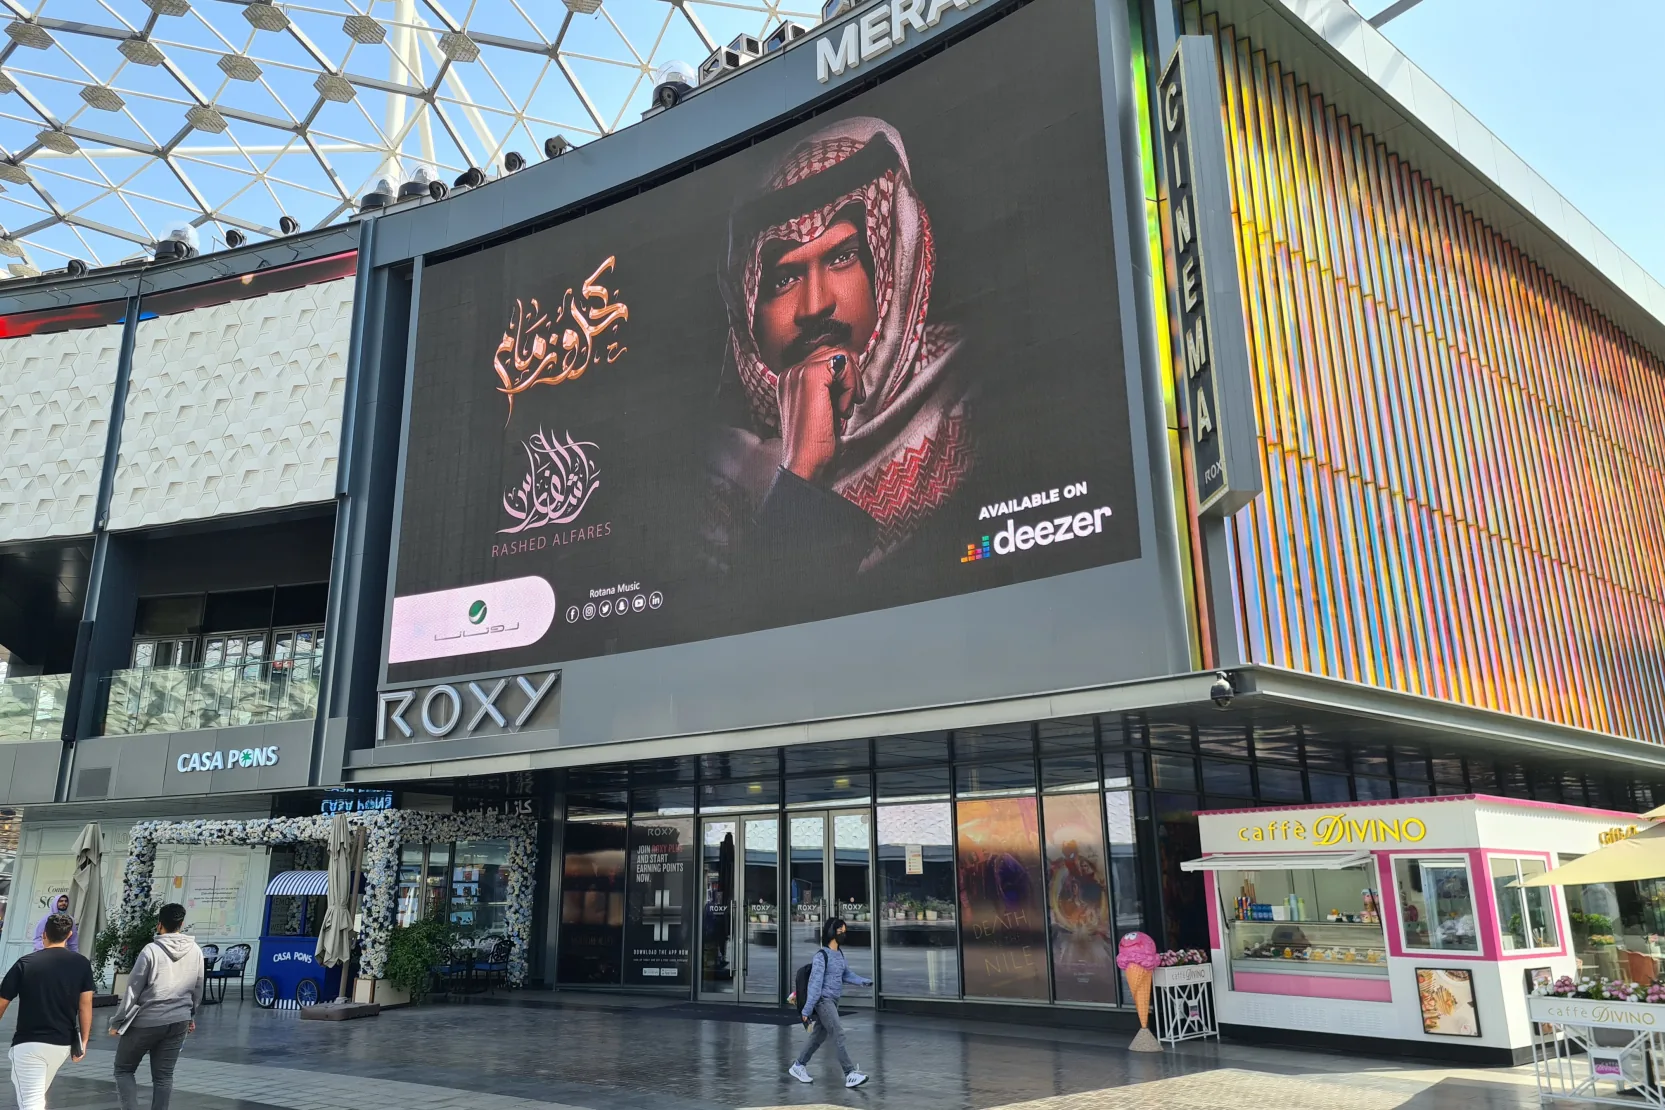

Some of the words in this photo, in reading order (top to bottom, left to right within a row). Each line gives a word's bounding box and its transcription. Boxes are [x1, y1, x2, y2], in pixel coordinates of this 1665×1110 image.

[816, 0, 980, 84] MER
[1165, 82, 1212, 442] CINEMA
[978, 488, 1060, 520] AVAILABLE
[1063, 481, 1088, 499] ON
[491, 536, 547, 557] RASHED
[552, 522, 611, 546] ALFARES
[993, 506, 1113, 555] deezer
[589, 587, 616, 598] Rotana
[617, 581, 640, 593] Music
[377, 672, 558, 741] ROXY
[177, 751, 225, 772] CASA
[227, 746, 279, 768] PONS
[648, 828, 674, 836] ROXY
[1238, 820, 1306, 842] caffè
[1312, 813, 1427, 846] DIVINO
[637, 845, 651, 854] JOIN
[651, 844, 667, 854] ROXY
[668, 843, 684, 853] PLUS
[637, 854, 649, 864] AND
[650, 854, 668, 863] START
[636, 863, 661, 873] EARNING
[662, 863, 684, 873] POINTS
[636, 873, 652, 883] NOW.
[842, 903, 863, 911] ROXY
[972, 908, 1028, 939] DEATH
[273, 952, 291, 962] CASA
[294, 952, 312, 964] PONS
[985, 945, 1035, 976] NILE
[1548, 1006, 1588, 1019] caffè
[1592, 1006, 1655, 1025] DIVINO
